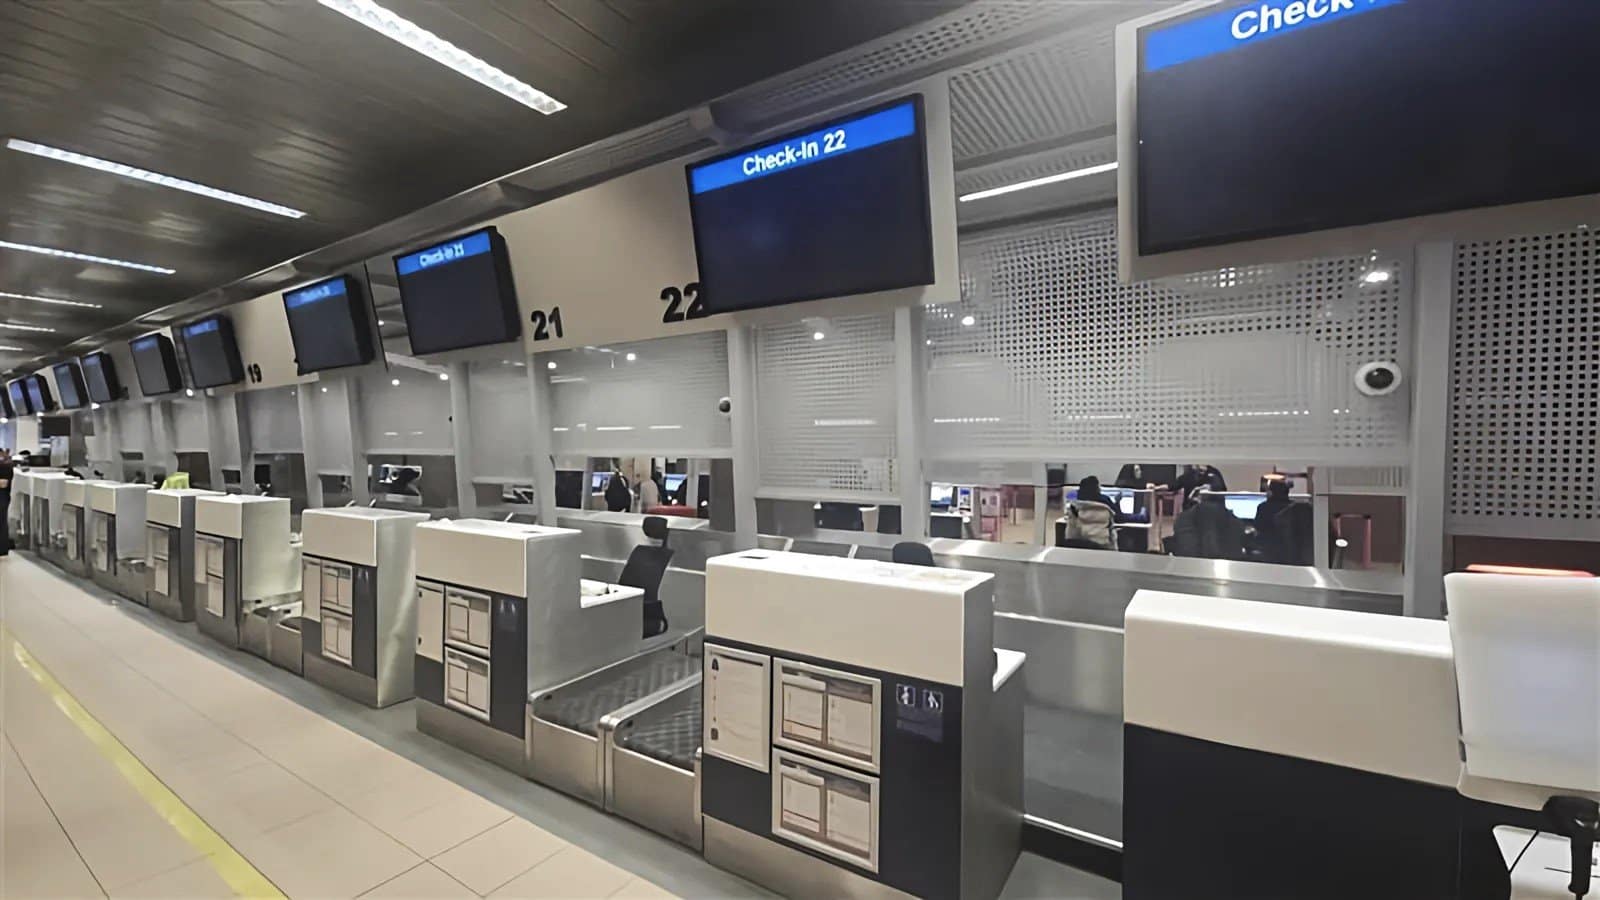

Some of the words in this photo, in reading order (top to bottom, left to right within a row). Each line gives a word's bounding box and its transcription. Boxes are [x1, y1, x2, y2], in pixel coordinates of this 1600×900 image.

[743, 141, 819, 175] Check-In
[823, 129, 846, 153] 22
[660, 282, 704, 323] 22
[531, 306, 563, 341] 21
[248, 363, 262, 384] 19
